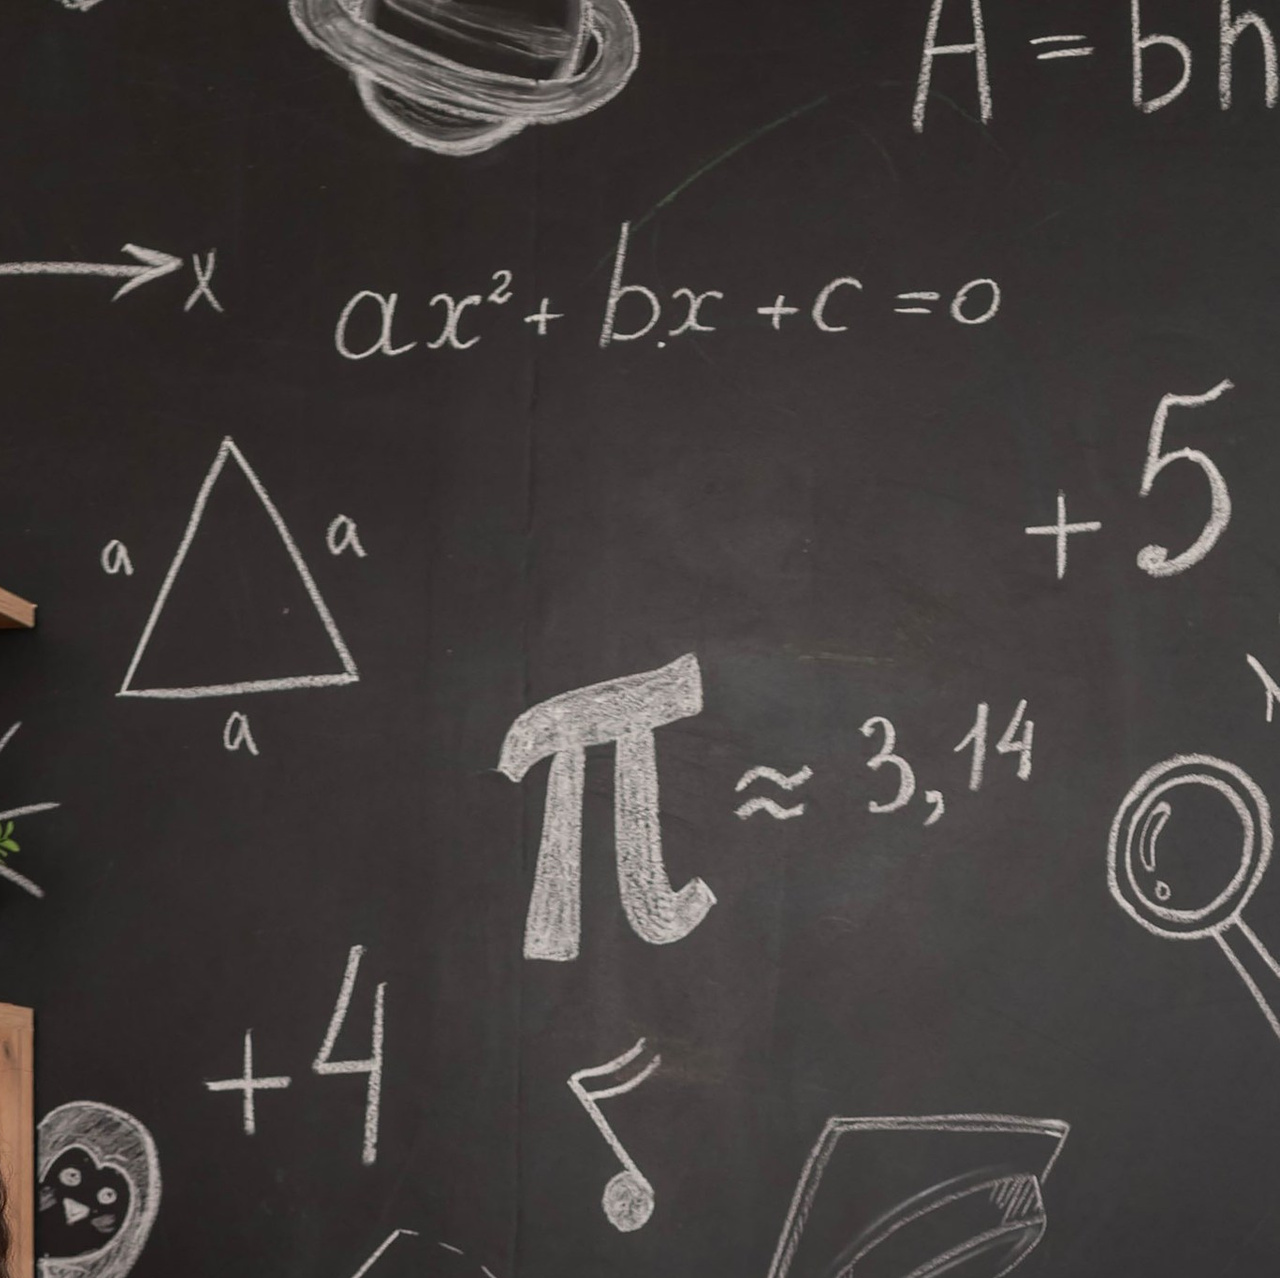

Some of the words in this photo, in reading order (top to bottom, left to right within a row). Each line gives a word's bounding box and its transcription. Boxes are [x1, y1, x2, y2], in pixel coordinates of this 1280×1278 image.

[912, 0, 993, 133] A
[184, 252, 223, 312] x
[101, 539, 134, 576] a
[326, 514, 368, 558] a
[223, 710, 260, 756] a
[857, 698, 1035, 827] 3,14
